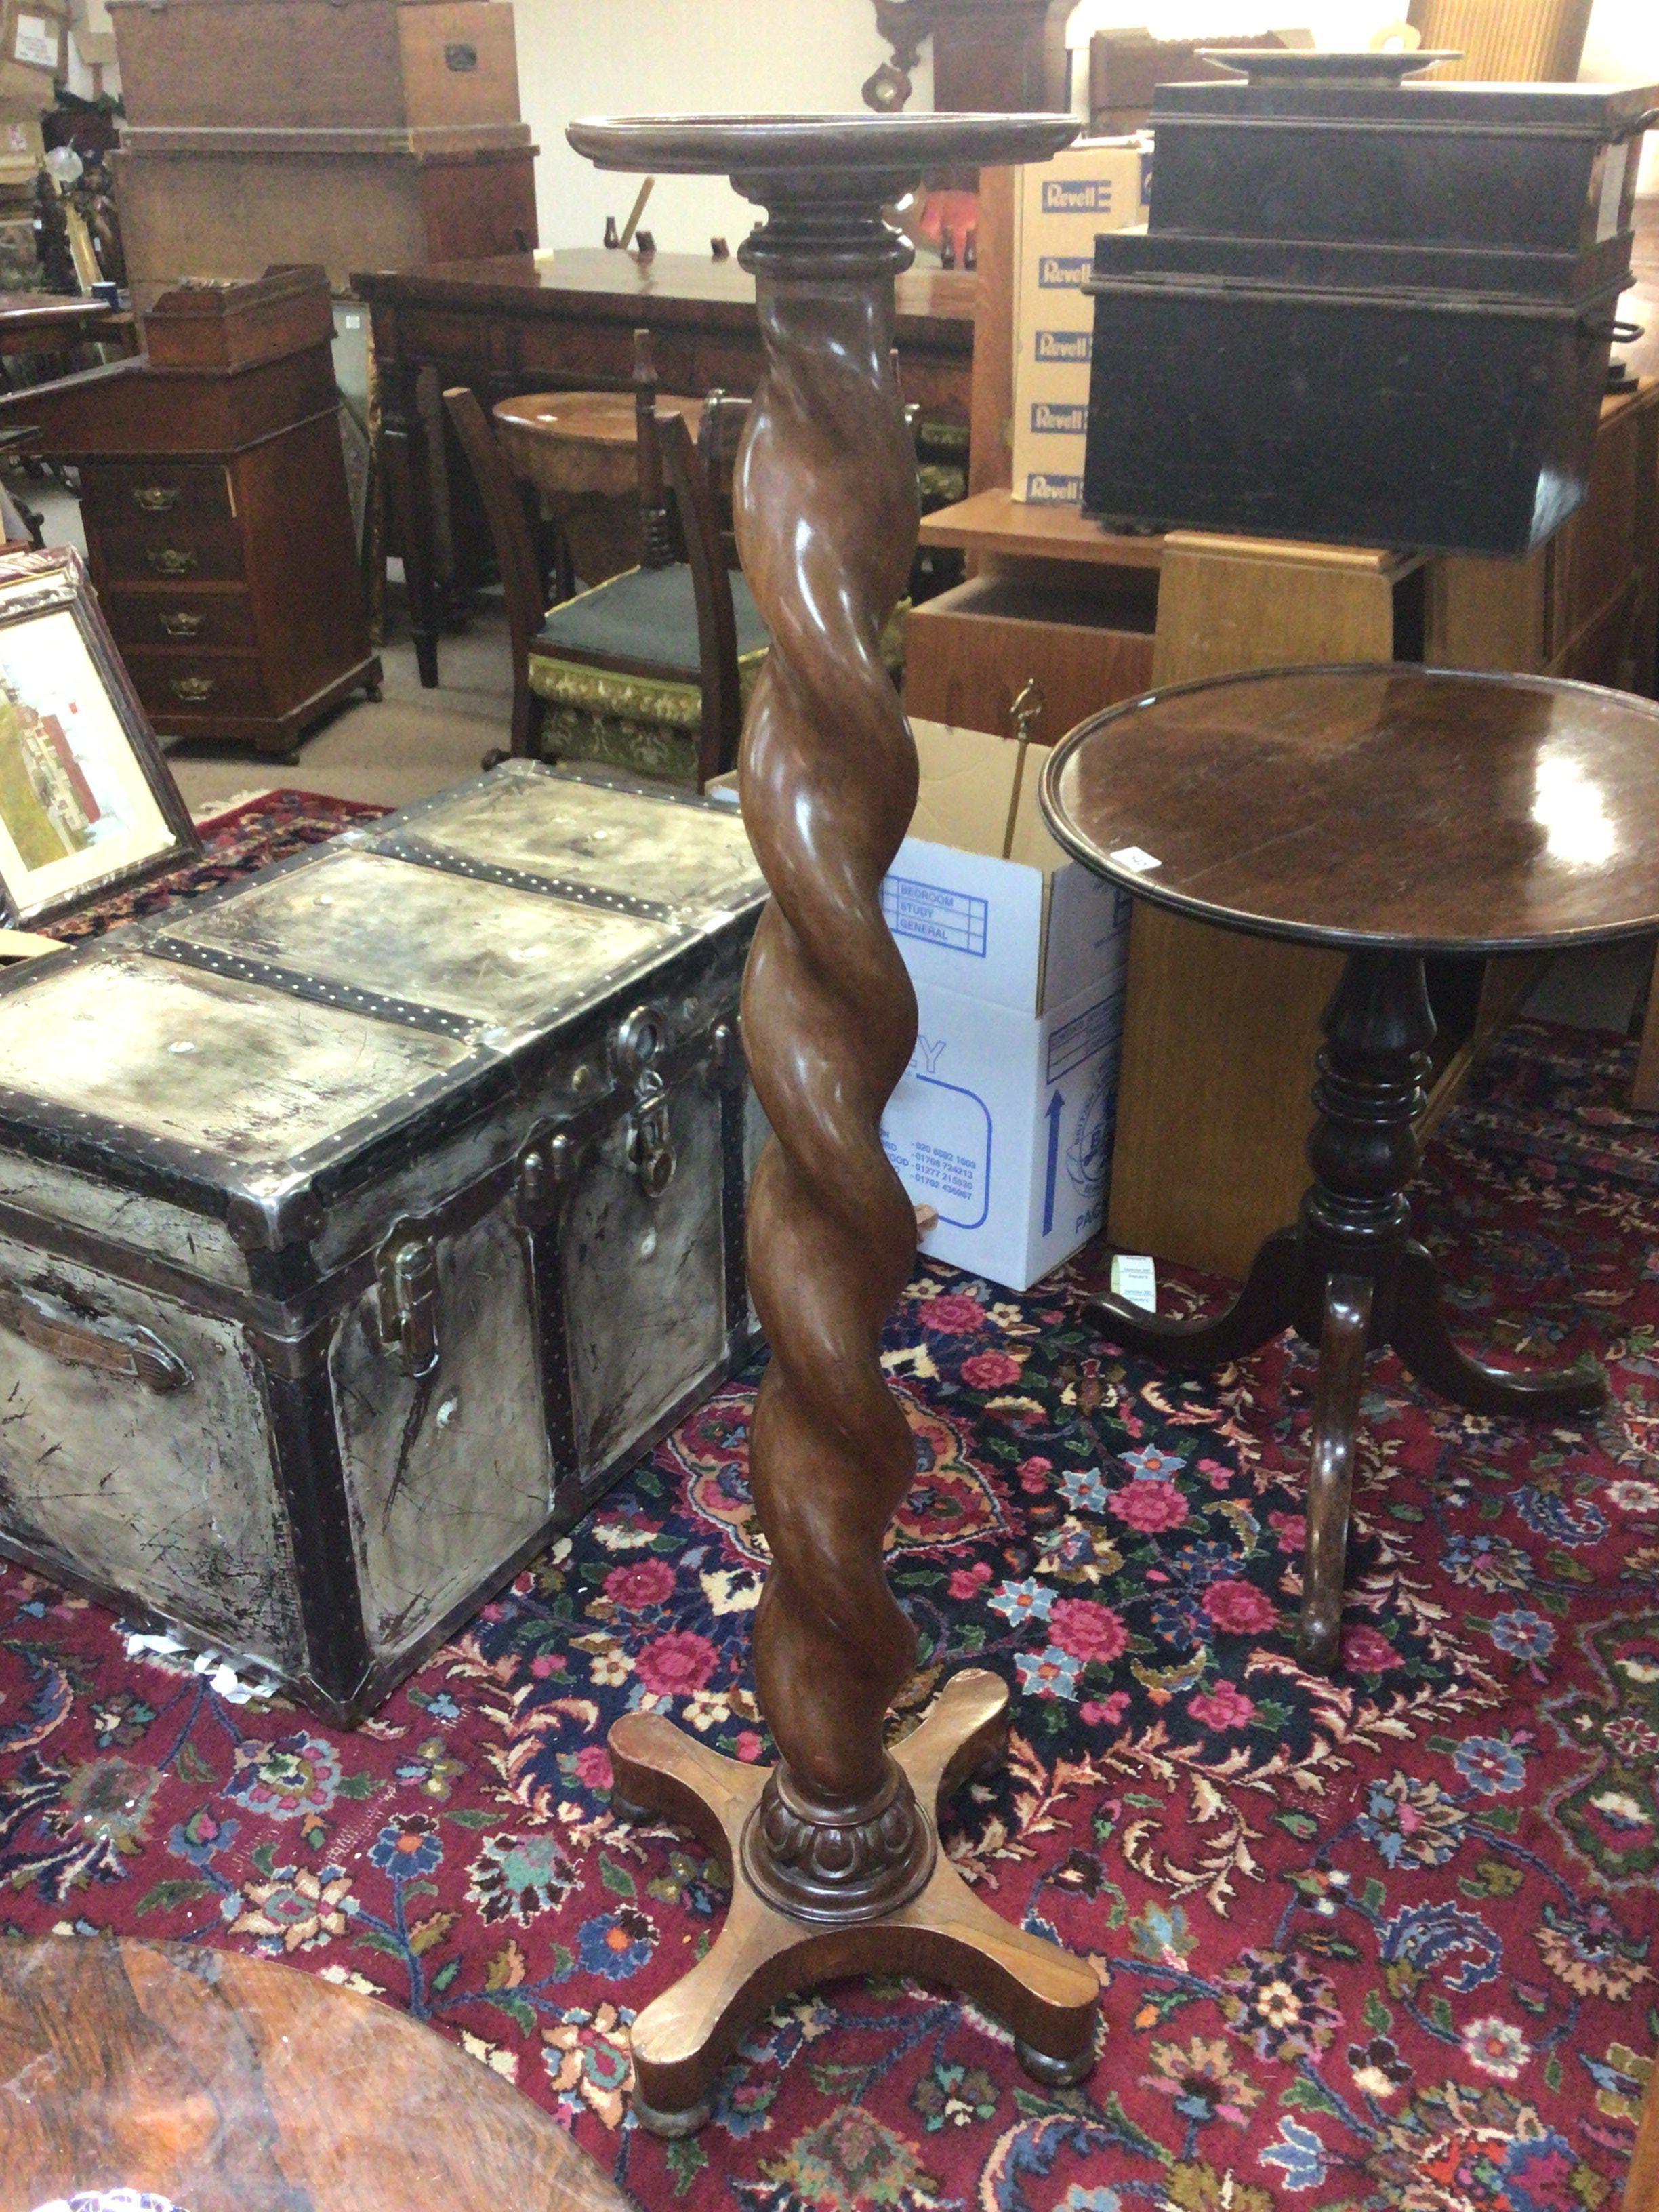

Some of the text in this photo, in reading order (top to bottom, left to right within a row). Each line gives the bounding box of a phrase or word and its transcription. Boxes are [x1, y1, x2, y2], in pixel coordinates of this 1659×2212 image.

[1047, 184, 1096, 207] Revell
[1044, 260, 1092, 283] Revell
[1040, 333, 1086, 357] Revell
[1036, 405, 1082, 429] Revell
[1031, 476, 1078, 499] Revell
[901, 884, 954, 907] BEDROOM
[900, 902, 934, 918] STUDY
[900, 918, 948, 940] GENERAL
